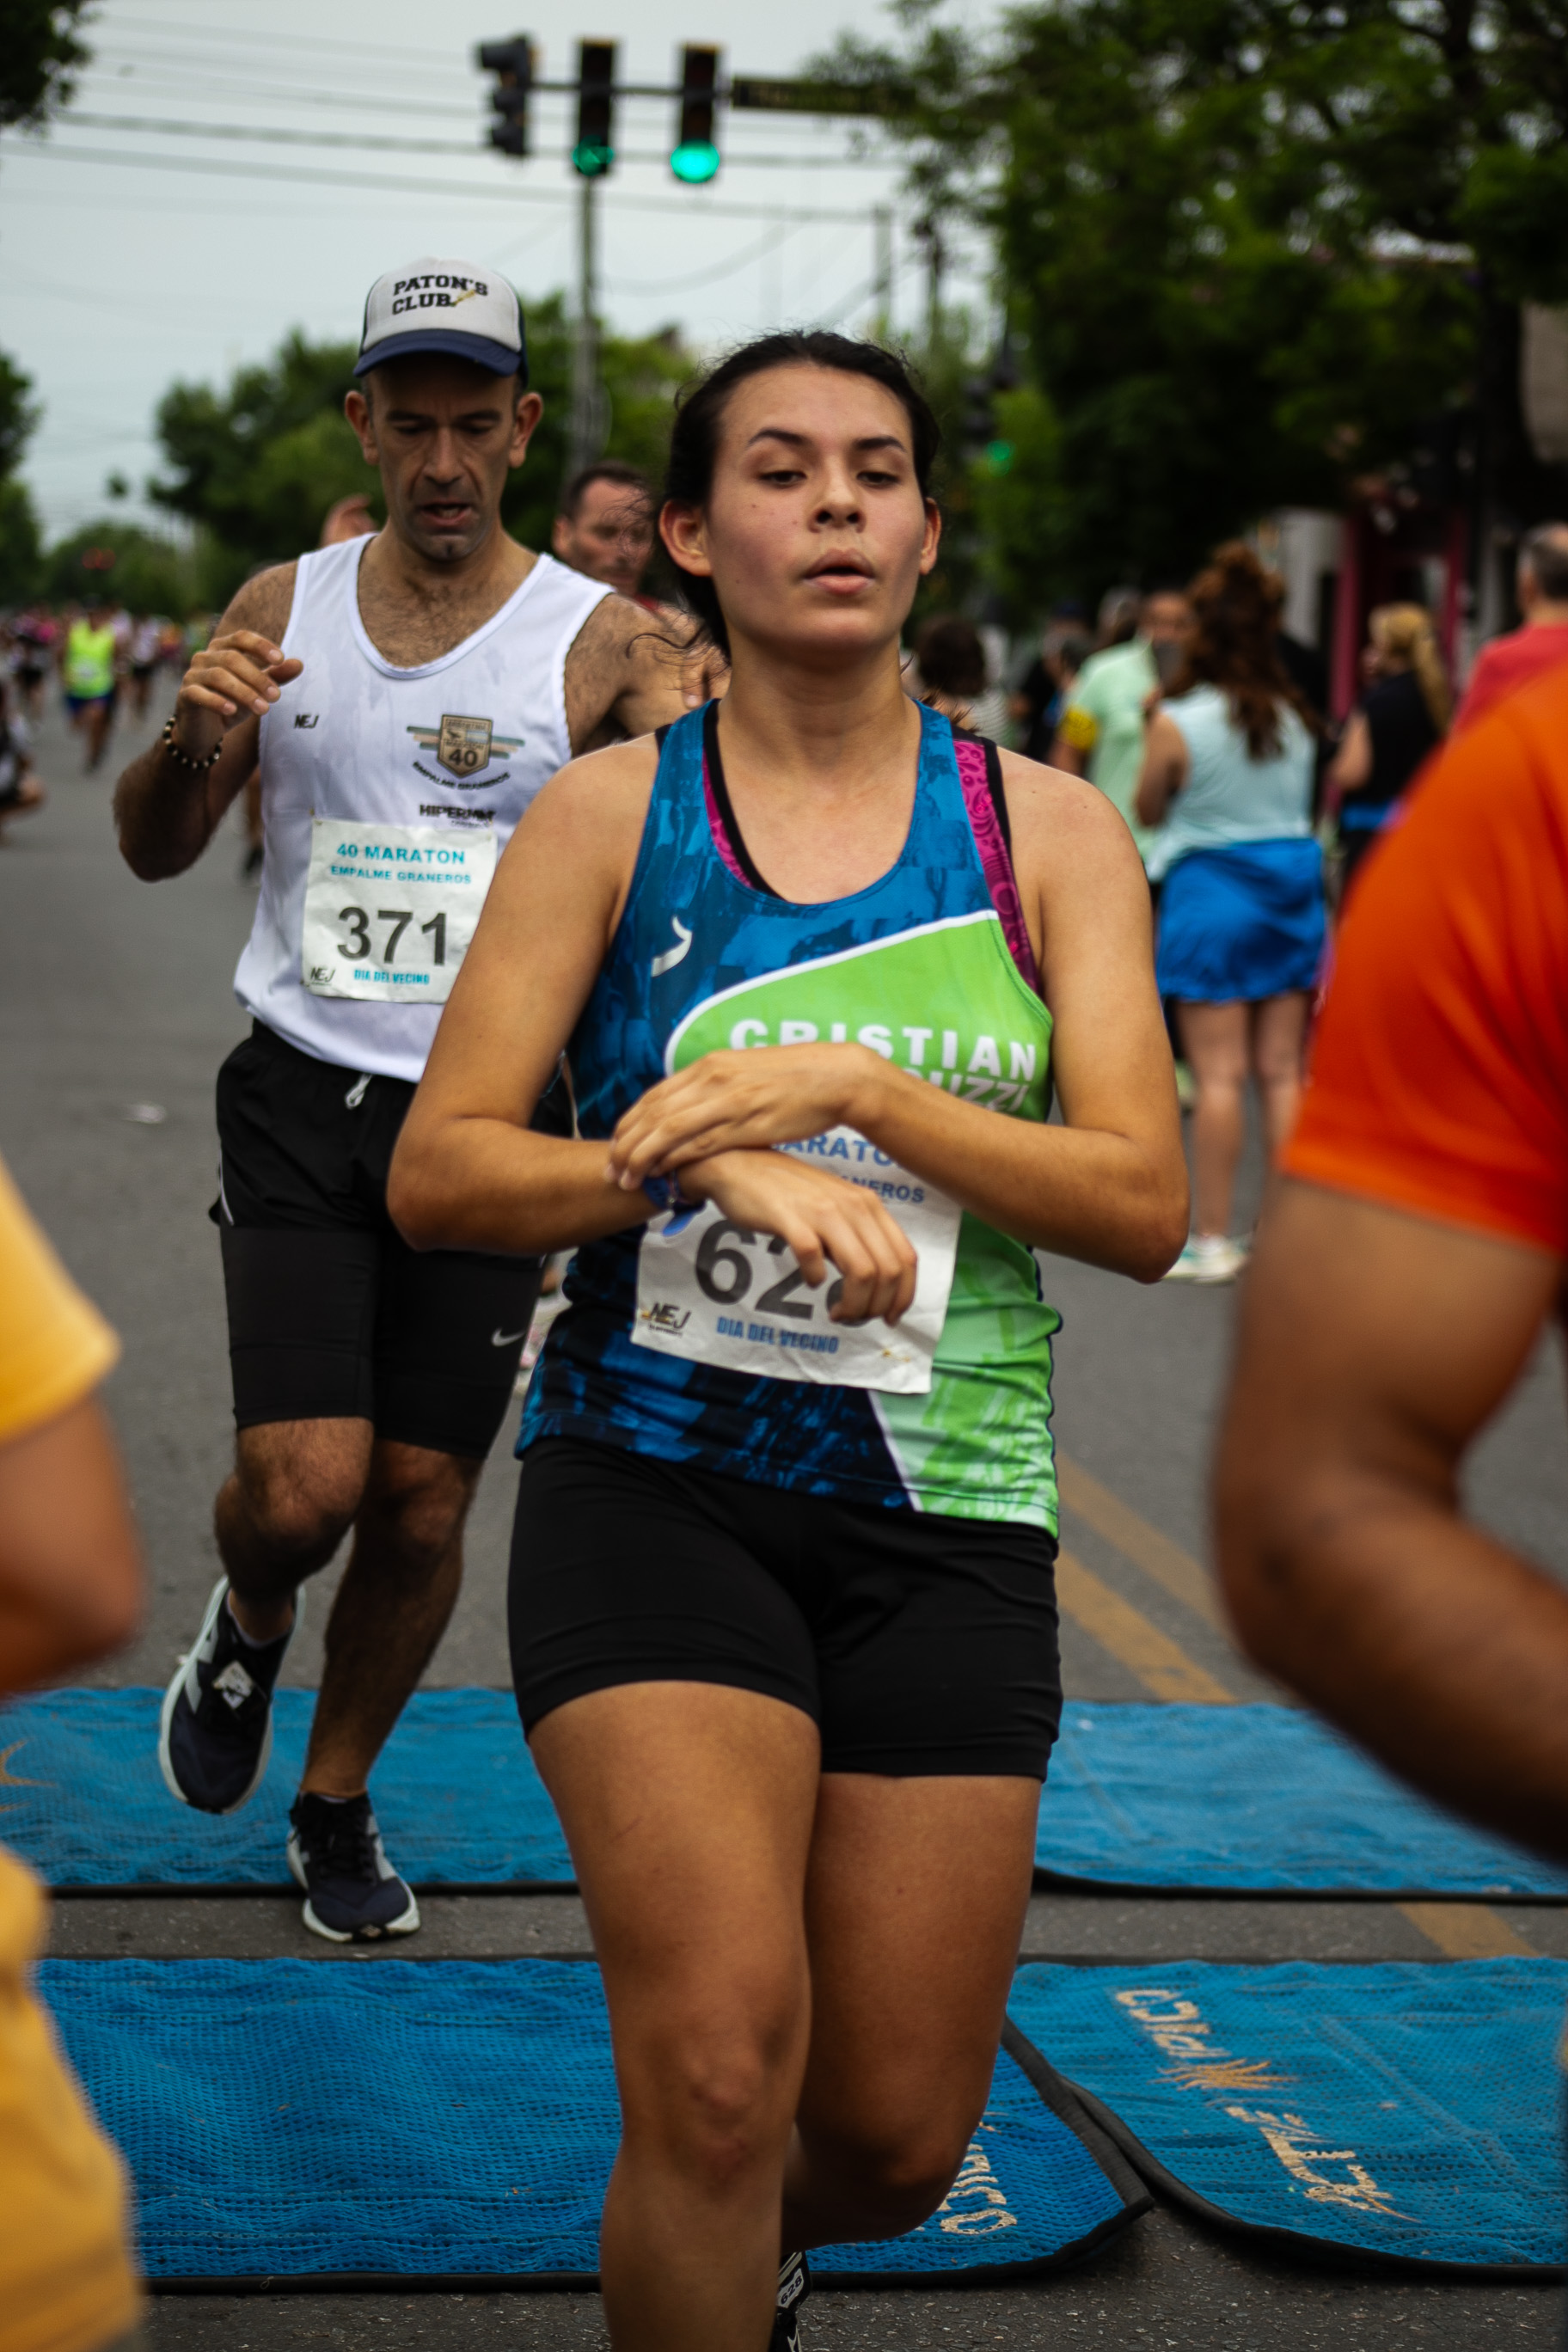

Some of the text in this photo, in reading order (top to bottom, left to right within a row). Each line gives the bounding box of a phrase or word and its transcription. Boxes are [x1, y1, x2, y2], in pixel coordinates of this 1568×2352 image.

[393, 275, 488, 297] PATON'S
[392, 293, 451, 315] CLUB
[294, 714, 319, 729] NEJ
[449, 749, 478, 768] 40
[337, 843, 465, 865] 40 MARATON
[330, 865, 472, 885] EMPALME GRANEROS
[337, 906, 446, 966] 371
[354, 969, 430, 986] DIA DEL VECINO
[695, 1219, 872, 1328] 62
[651, 1302, 691, 1329] NEJ
[717, 1316, 840, 1355] DIA DEL VECINO
[781, 2275, 803, 2305] 628
